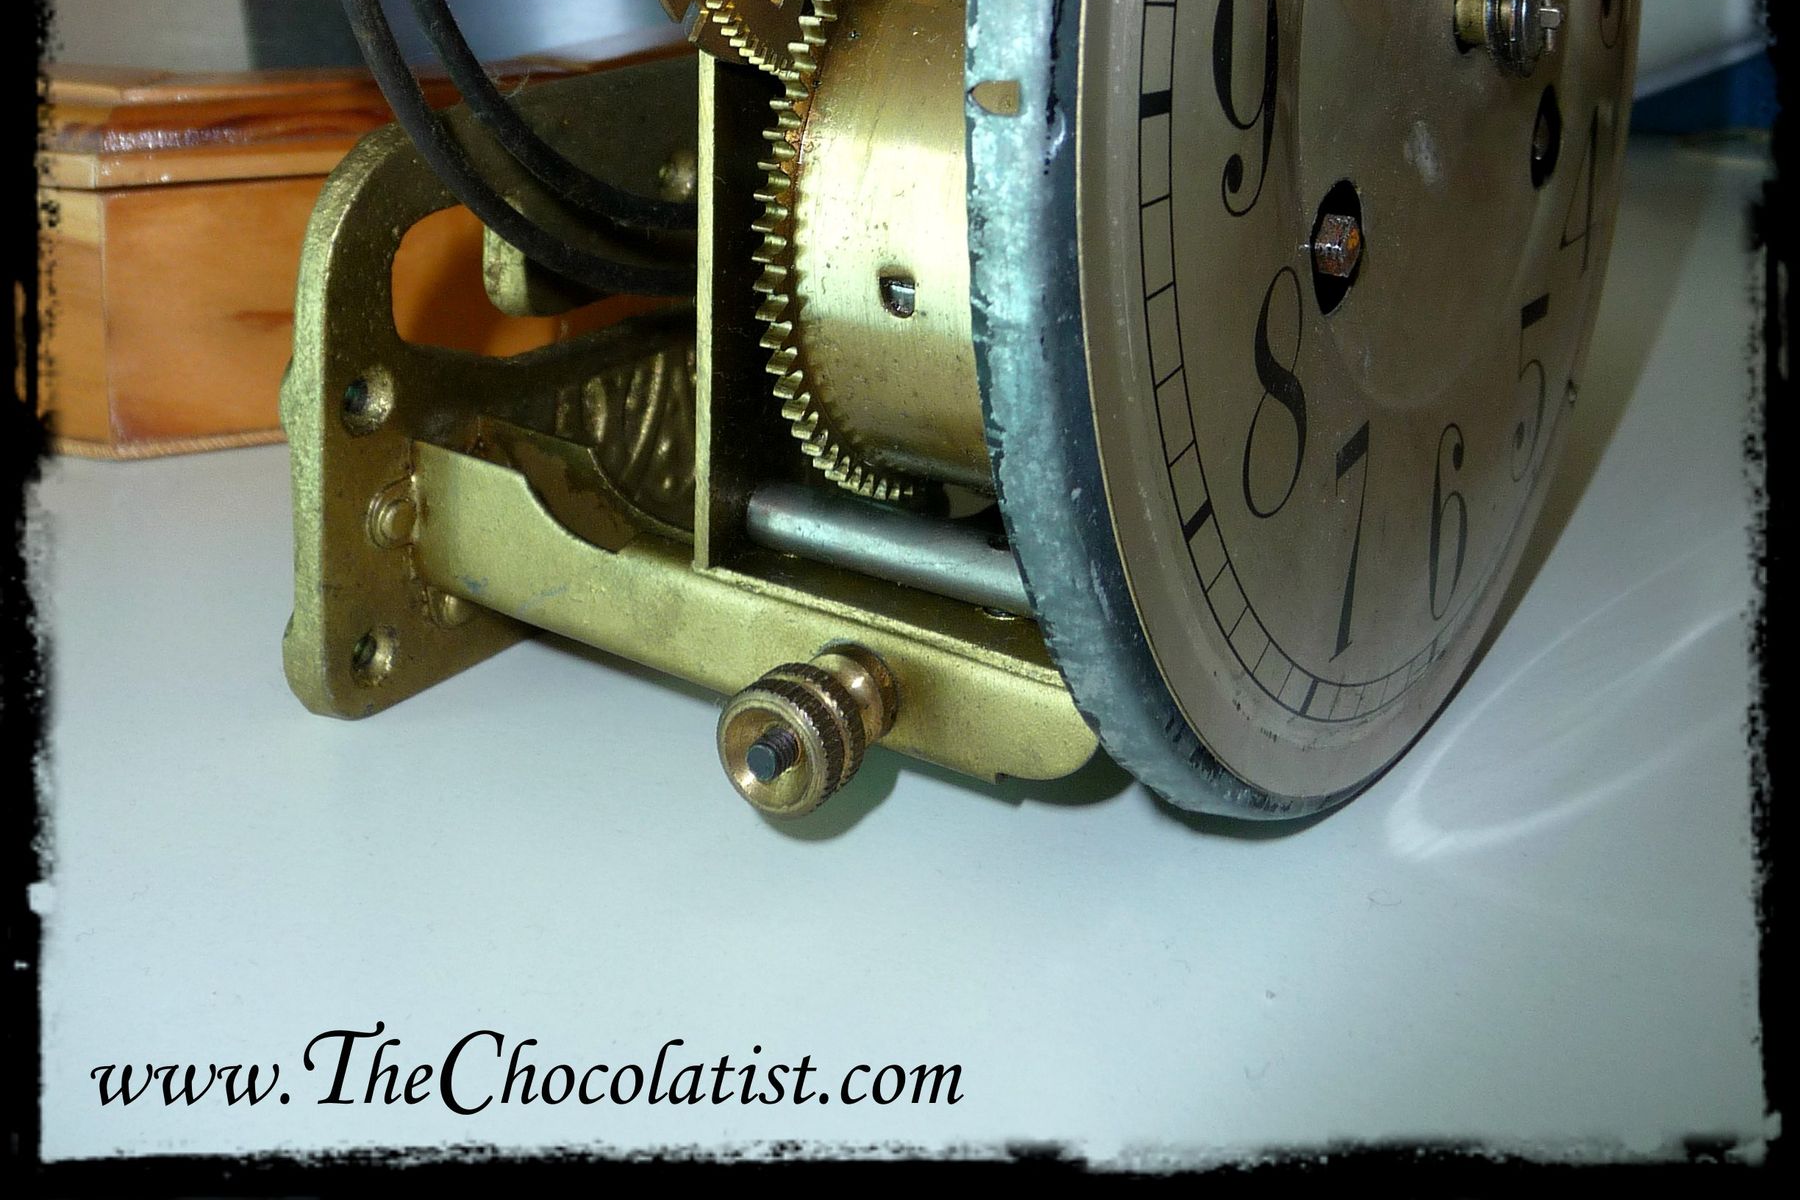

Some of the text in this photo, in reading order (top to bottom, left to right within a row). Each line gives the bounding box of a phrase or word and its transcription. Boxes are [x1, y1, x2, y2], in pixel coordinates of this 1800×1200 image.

[1560, 107, 1598, 274] 4
[1242, 266, 1306, 518] 8
[1511, 293, 1549, 482] 5
[1329, 421, 1370, 662] 7
[1428, 423, 1468, 621] 6
